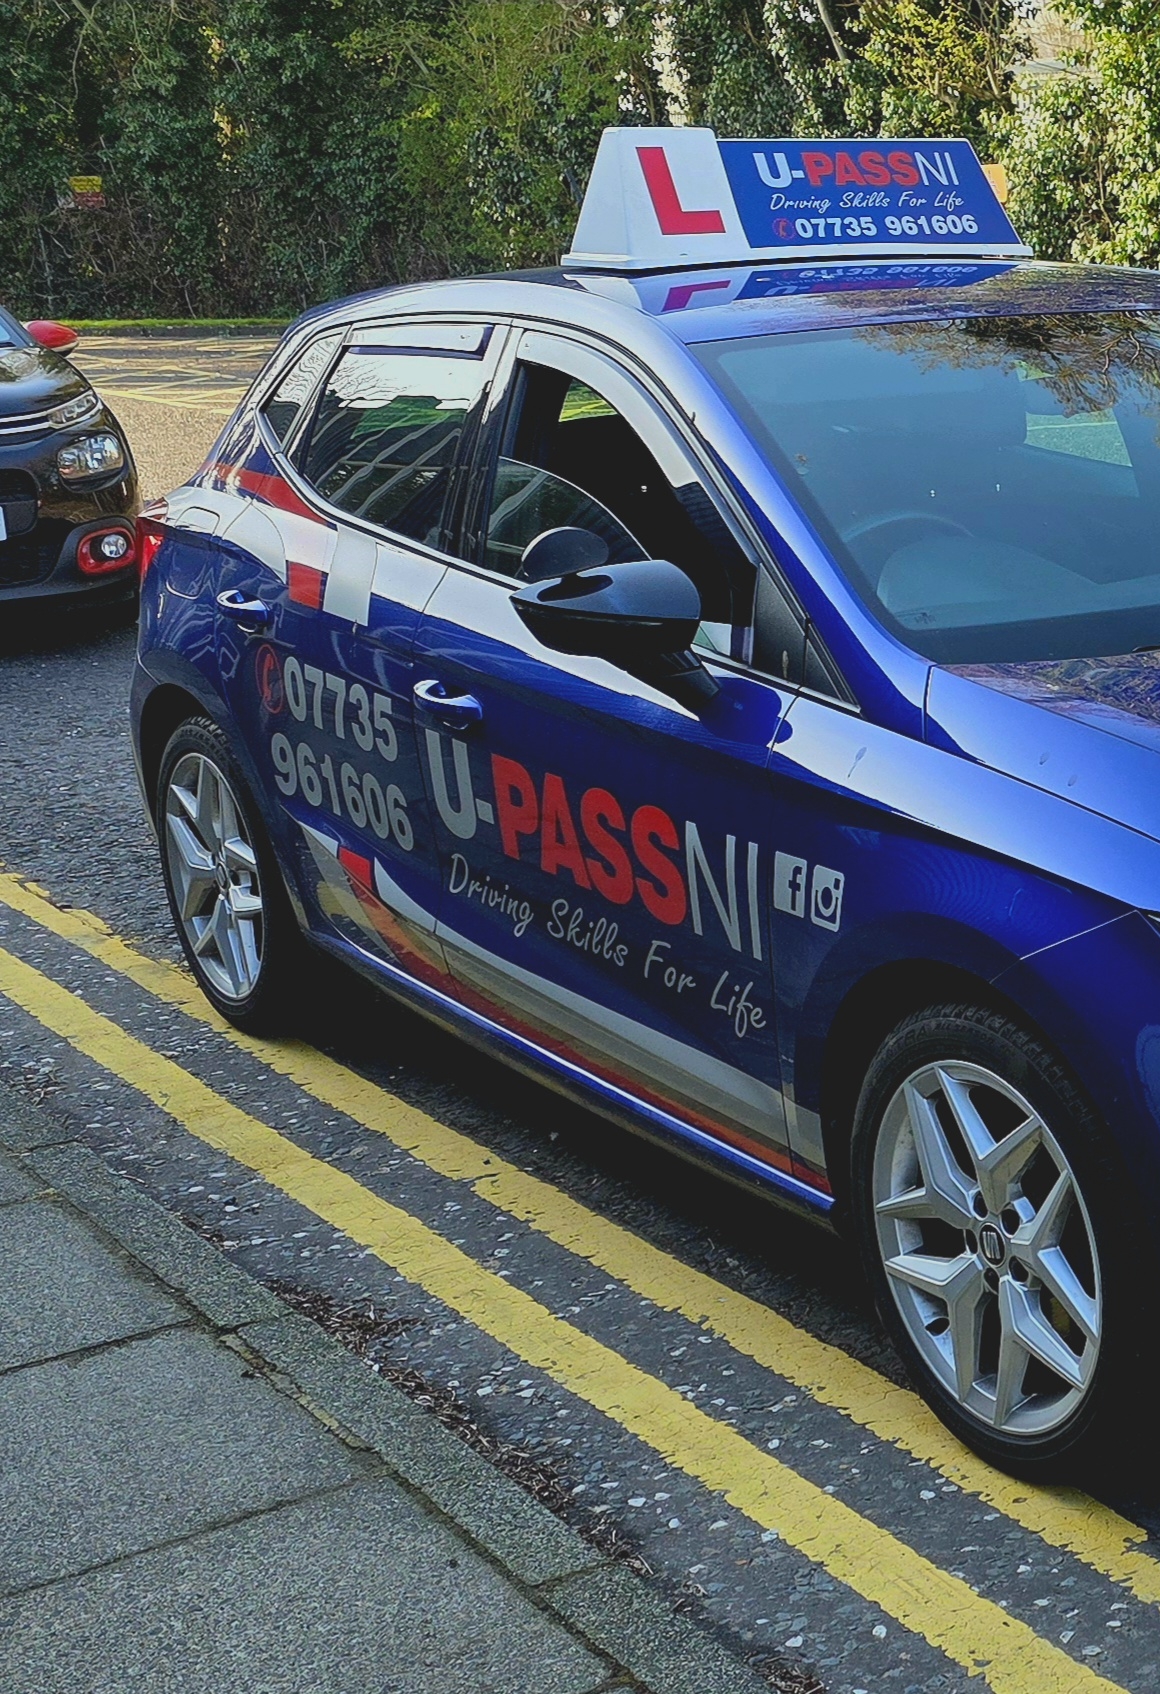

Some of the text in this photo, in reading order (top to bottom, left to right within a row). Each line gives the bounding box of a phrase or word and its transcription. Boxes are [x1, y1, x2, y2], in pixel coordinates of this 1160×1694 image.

[635, 146, 726, 235] L
[752, 151, 960, 188] U-PASSNI
[770, 191, 965, 213] Driving Skills For Life
[794, 214, 979, 238] 07735 961606
[283, 656, 398, 762] 07735
[271, 732, 415, 851] 961606
[426, 730, 763, 961] U-PASSNI
[449, 853, 766, 1037] Driving Skills For Life
